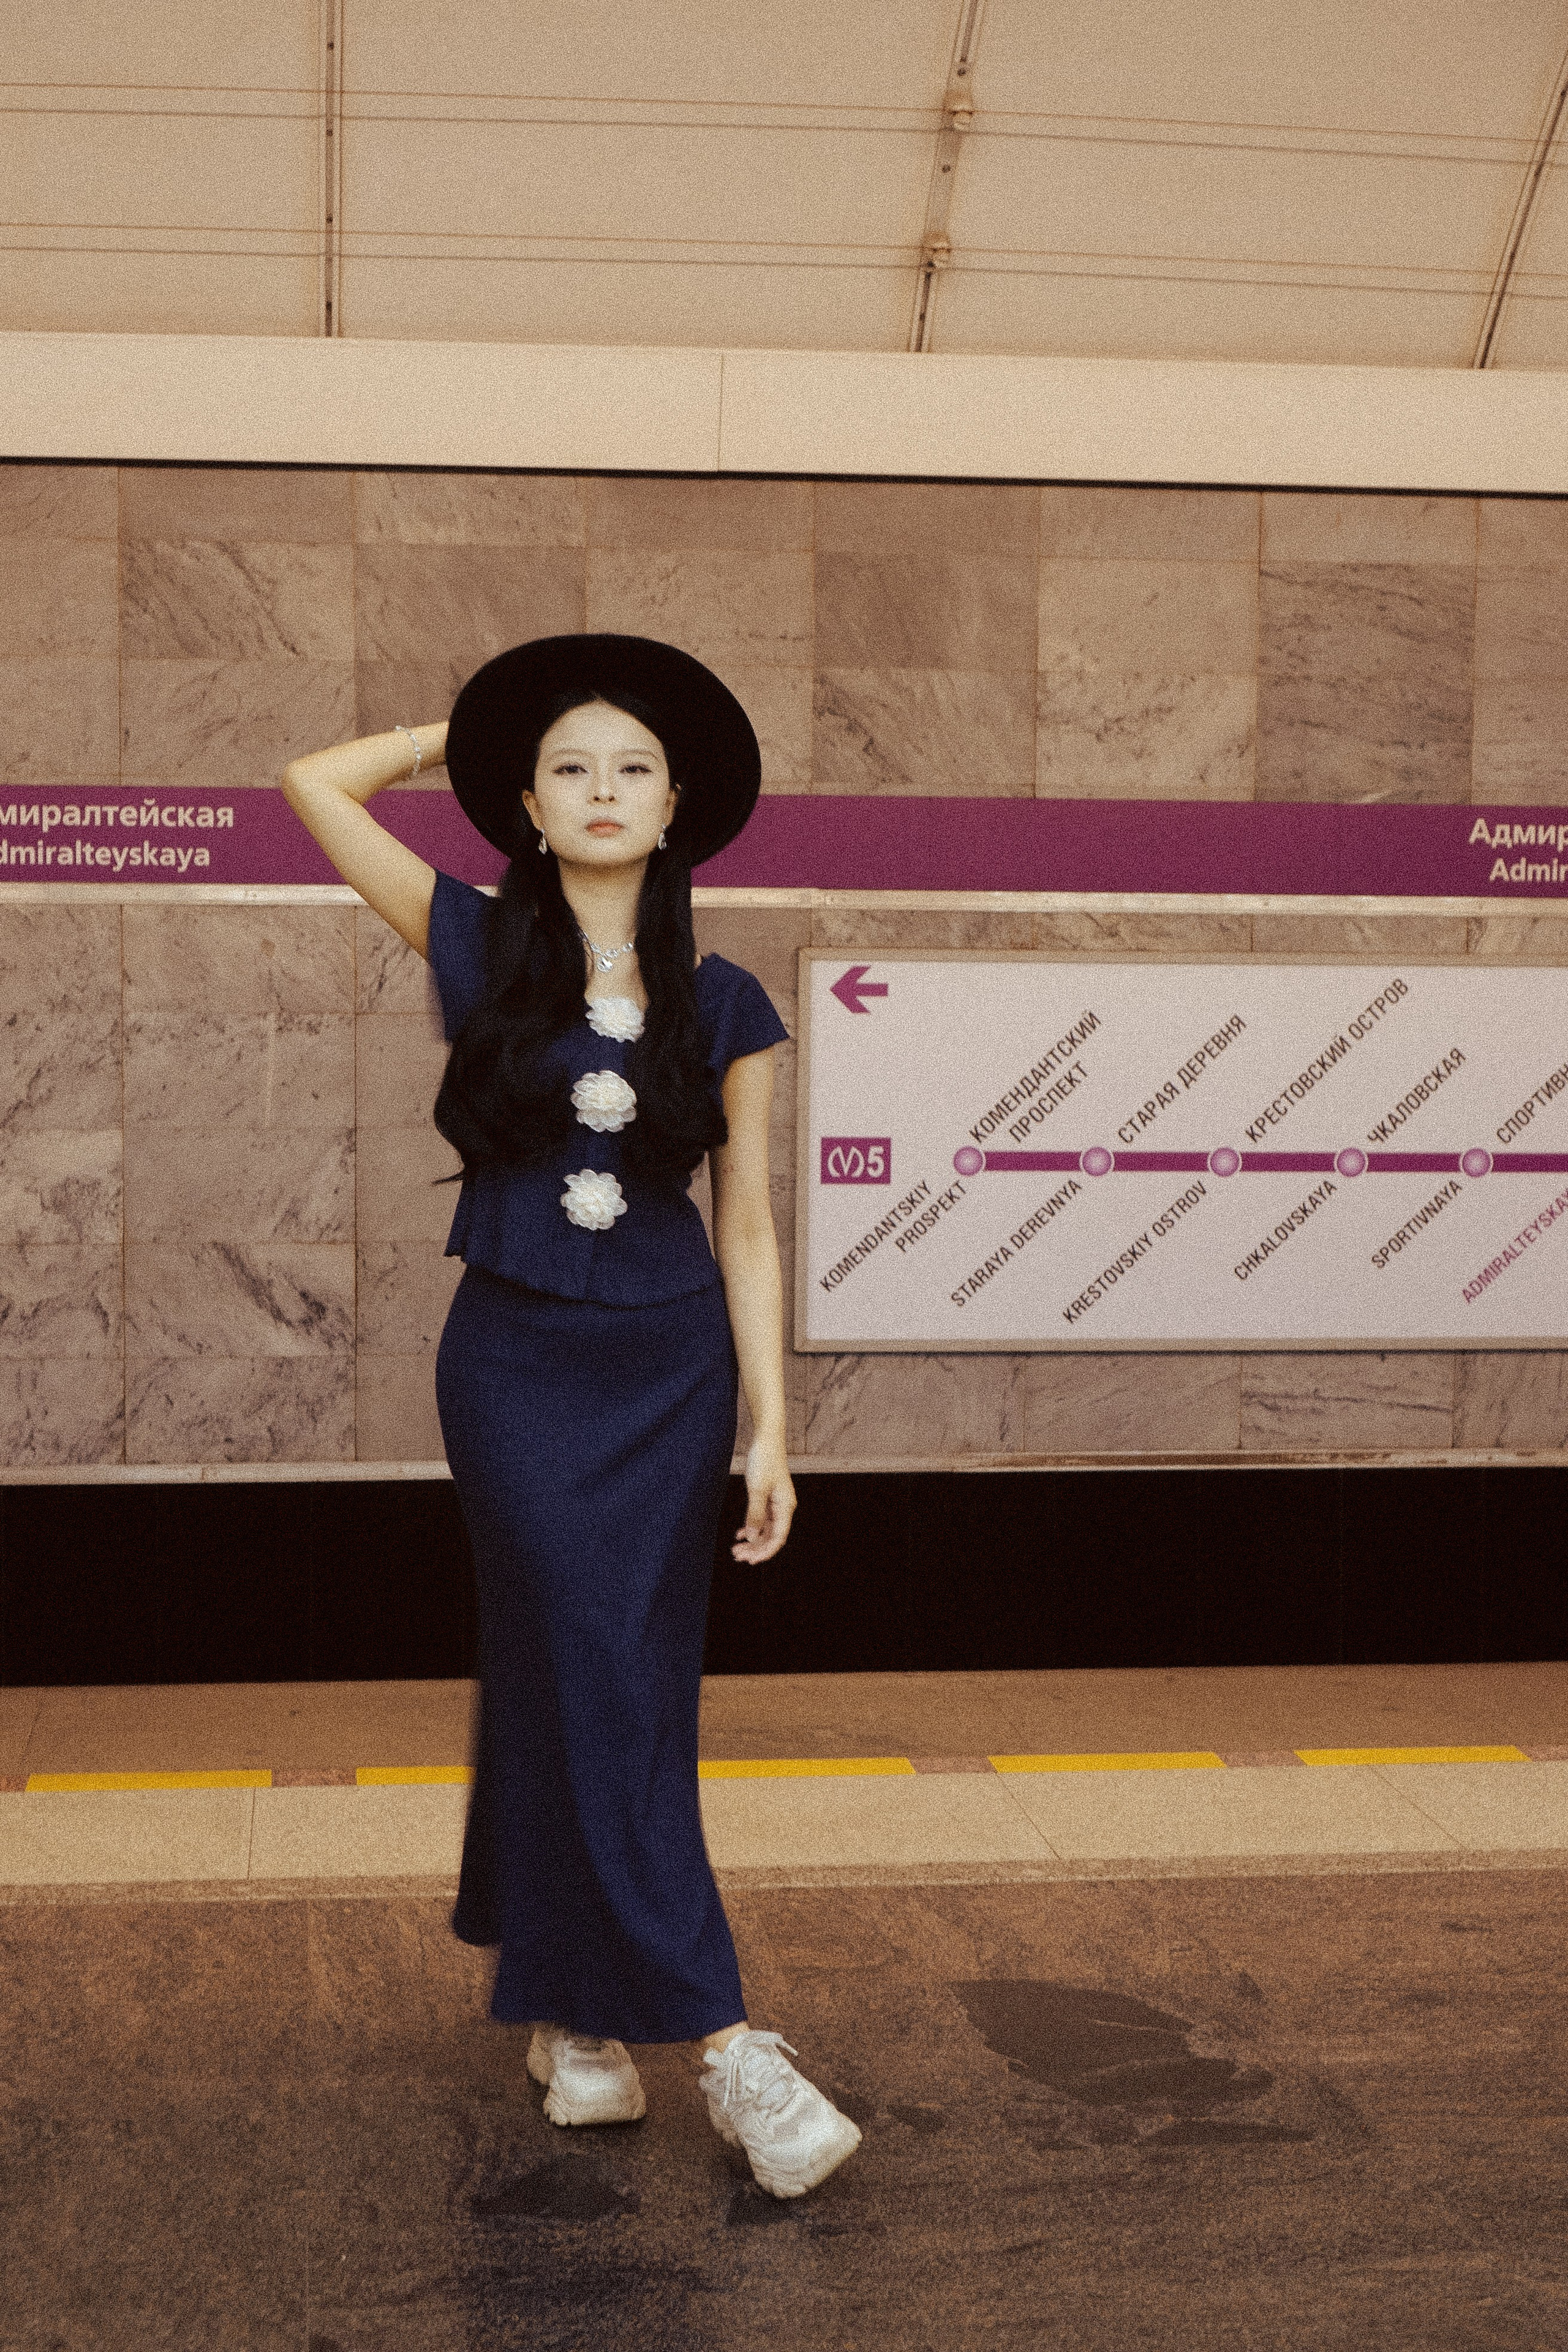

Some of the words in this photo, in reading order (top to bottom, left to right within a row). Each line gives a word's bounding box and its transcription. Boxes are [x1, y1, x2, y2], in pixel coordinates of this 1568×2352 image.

[969, 1009, 1101, 1144] КОМЕНДАНТСКИЙ
[1008, 1060, 1088, 1143] ПРОСПЕКТ
[1118, 1082, 1180, 1144] СТАРАЯ
[1177, 1015, 1247, 1089] ДЕРЕВНЯ
[1245, 1033, 1352, 1144] КРЕСТОВСКИЙ
[1349, 978, 1409, 1041] ОСТРОВ
[1368, 1047, 1466, 1145] ЧКАЛОВСКАЯ
[820, 1180, 932, 1293] KOMENDANTSKIY
[894, 1181, 966, 1252] PROSPEKT
[951, 1248, 1013, 1307] STARAYA
[1011, 1180, 1082, 1251] DEREVNYA
[1063, 1234, 1153, 1324] KRESTOVSKIY
[1152, 1180, 1207, 1238] OSTROV
[1234, 1180, 1337, 1281] CHKALOVSKAYA
[1371, 1180, 1462, 1269] SPORTIVNAYA
